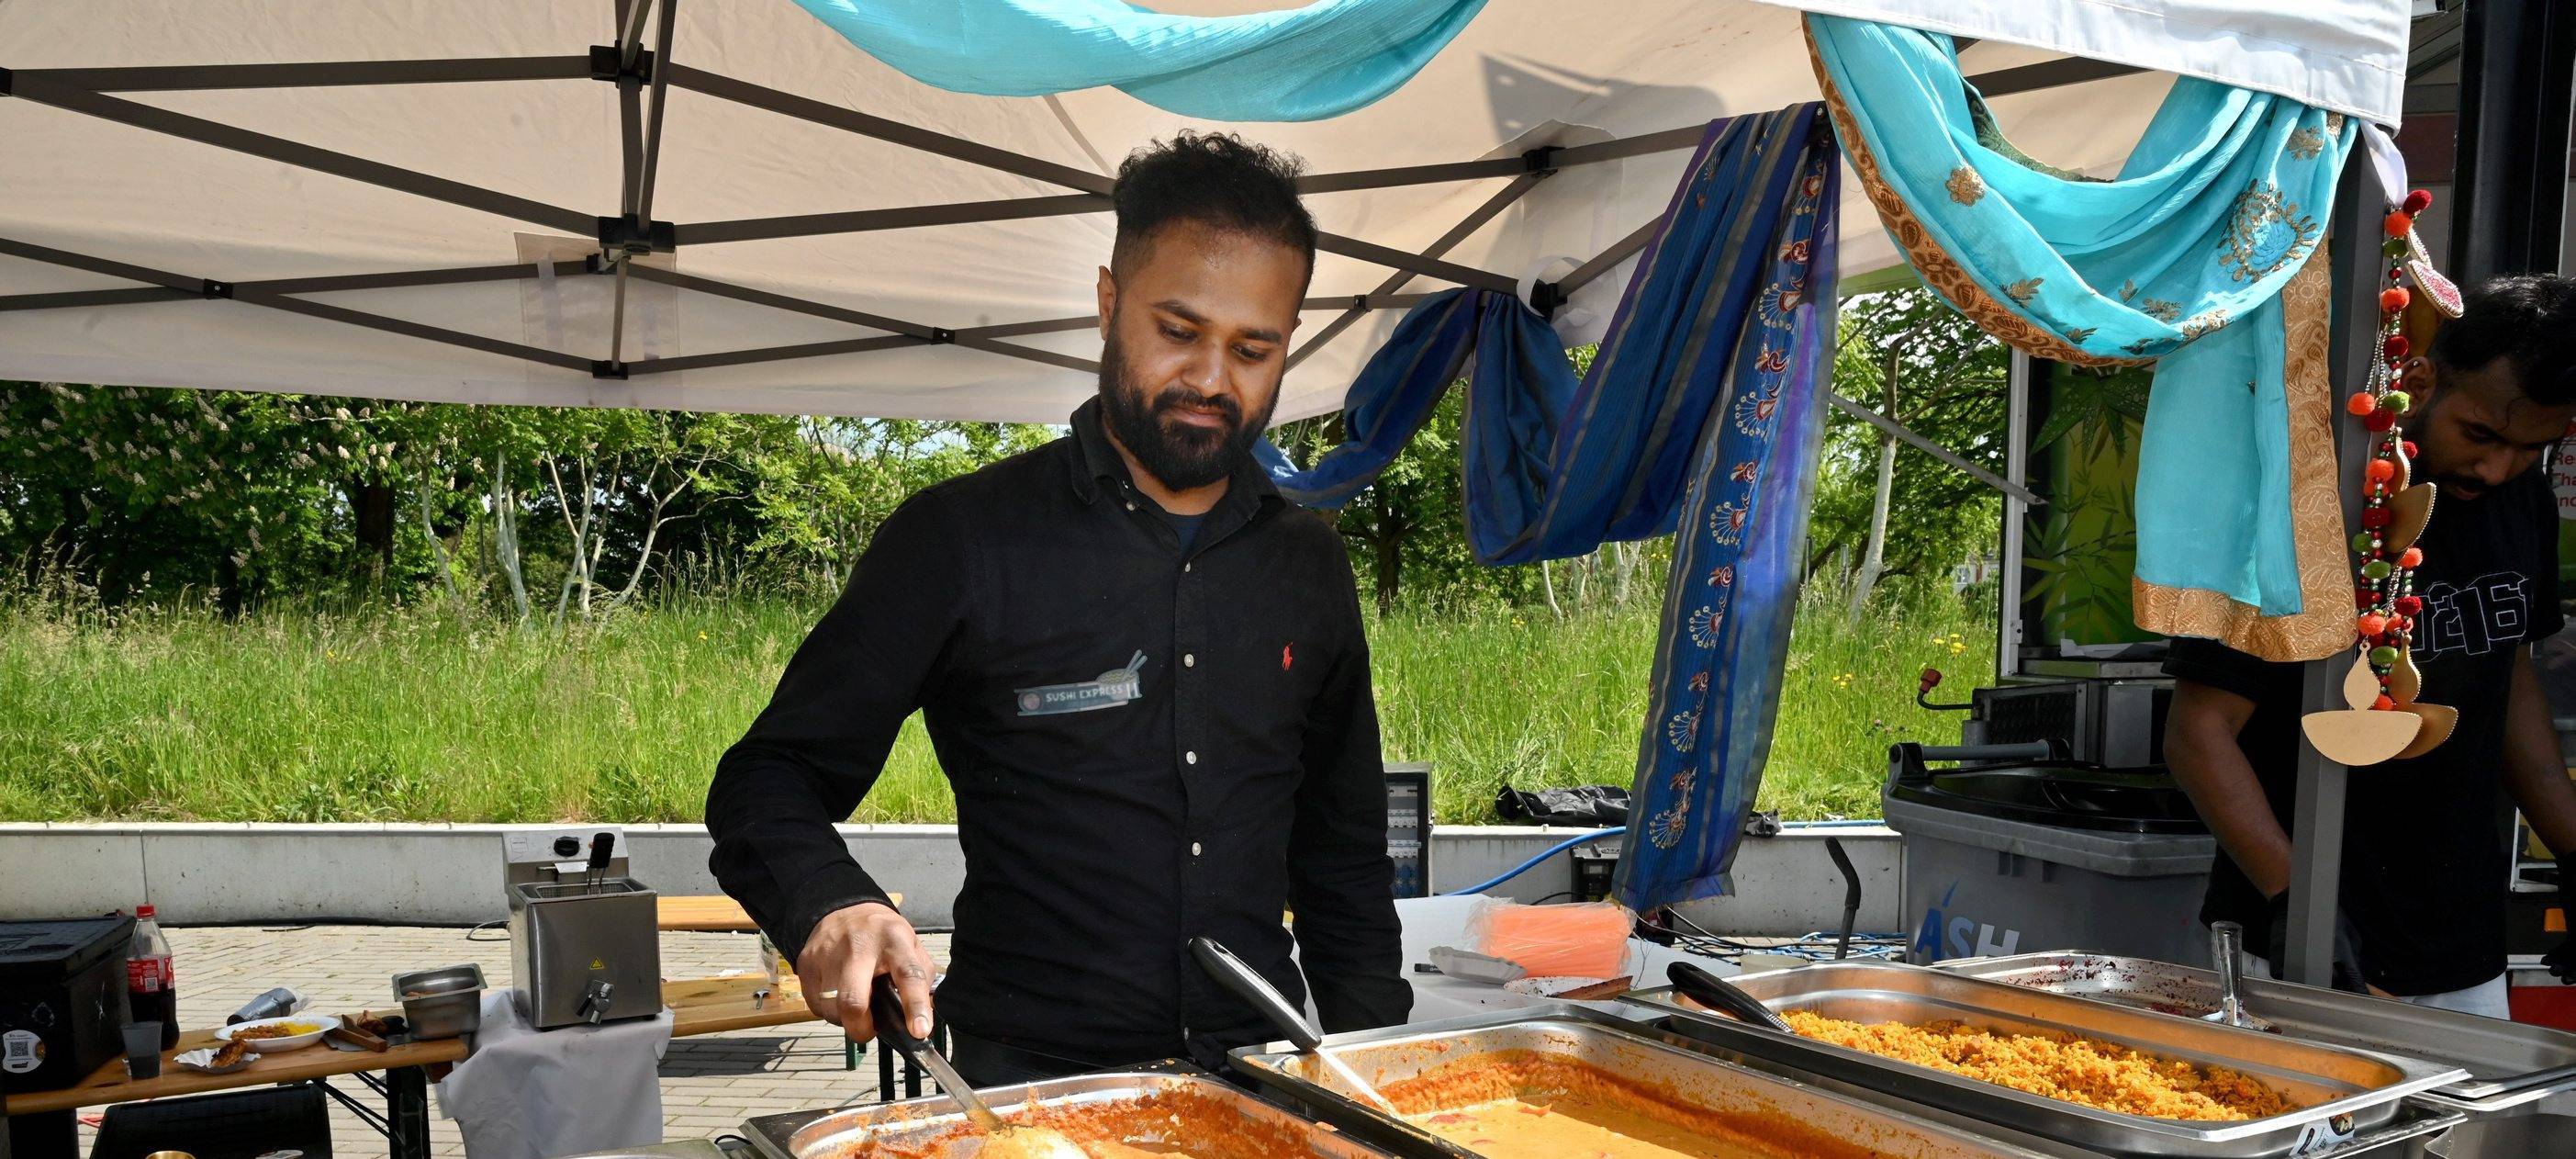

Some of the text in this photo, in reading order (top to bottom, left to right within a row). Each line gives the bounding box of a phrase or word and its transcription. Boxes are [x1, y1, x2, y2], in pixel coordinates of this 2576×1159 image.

[2556, 453, 2576, 465] Re
[1046, 685, 1123, 703] SUSHI EXPRESS
